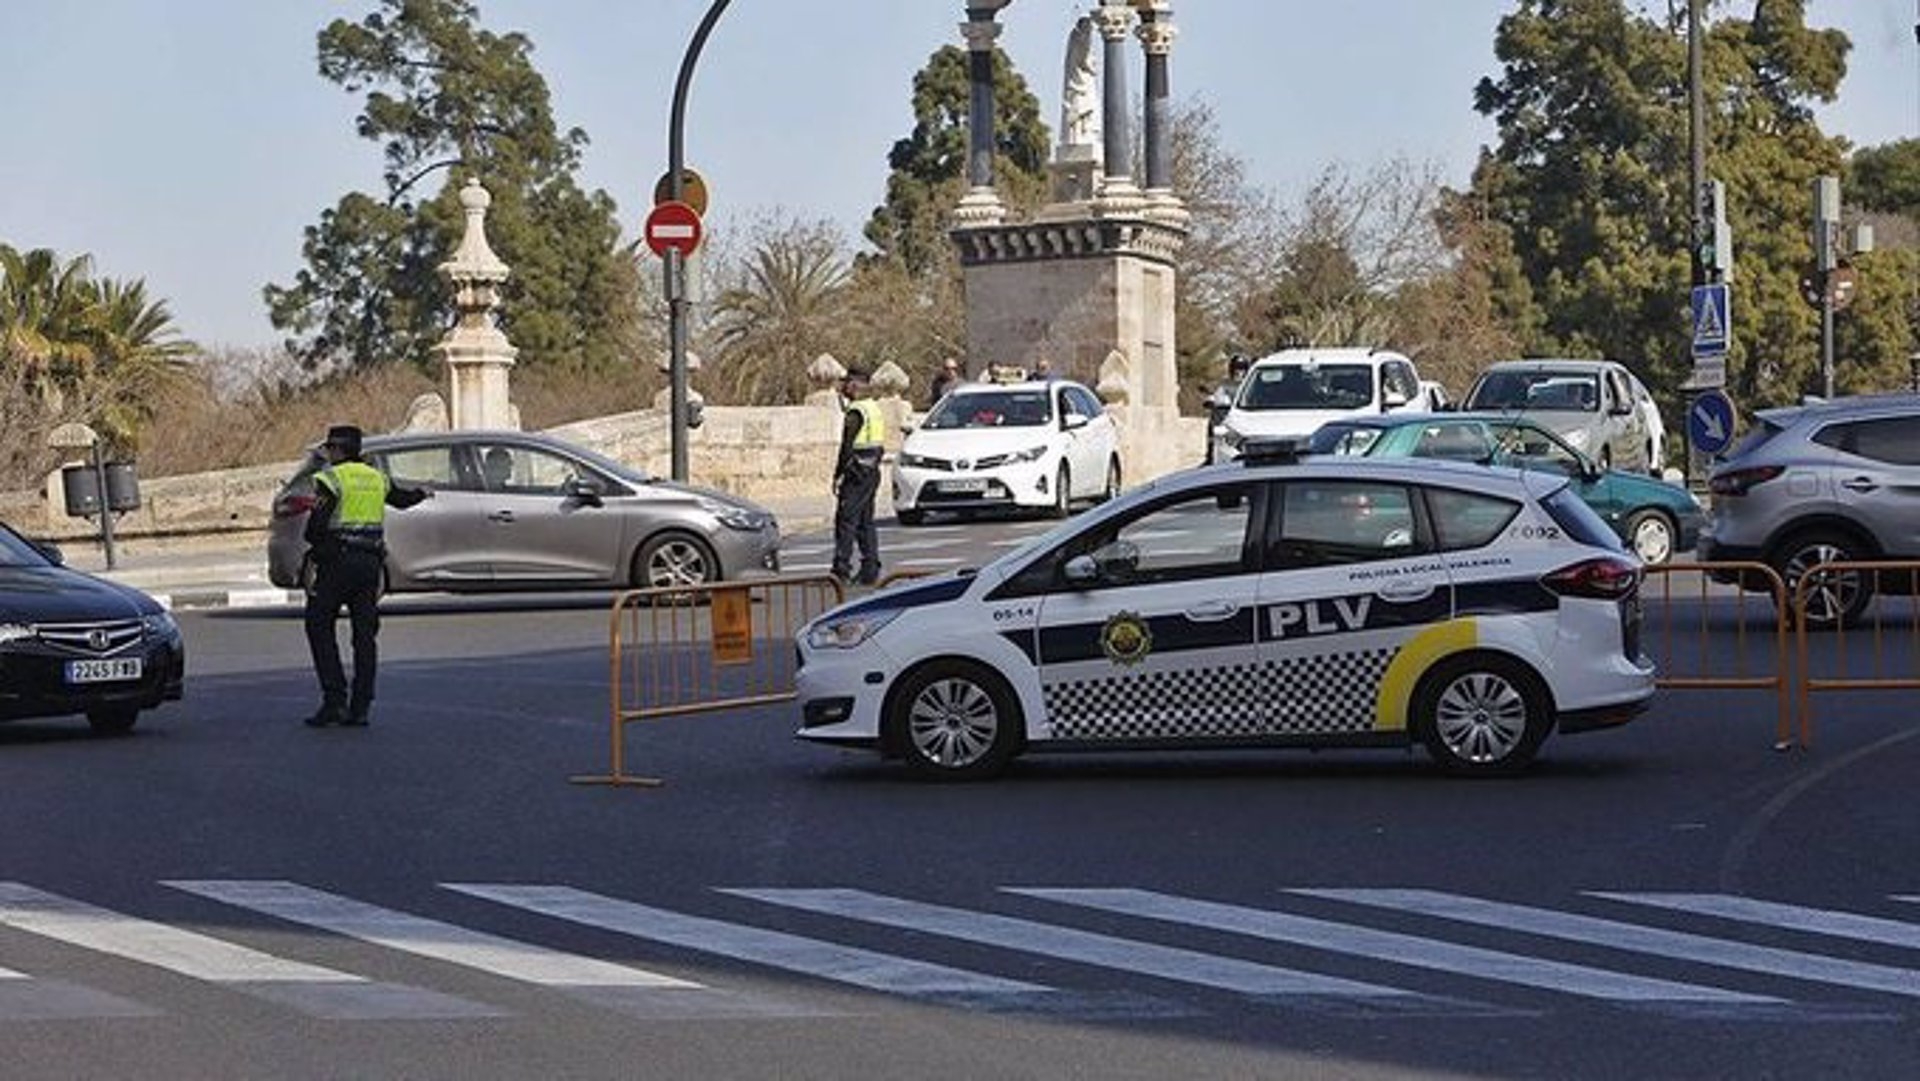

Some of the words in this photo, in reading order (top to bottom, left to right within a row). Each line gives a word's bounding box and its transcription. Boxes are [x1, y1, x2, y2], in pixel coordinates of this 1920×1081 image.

[1402, 563, 1443, 574] LOCAL
[1449, 557, 1512, 570] VALENCIA
[1269, 595, 1372, 637] PLV
